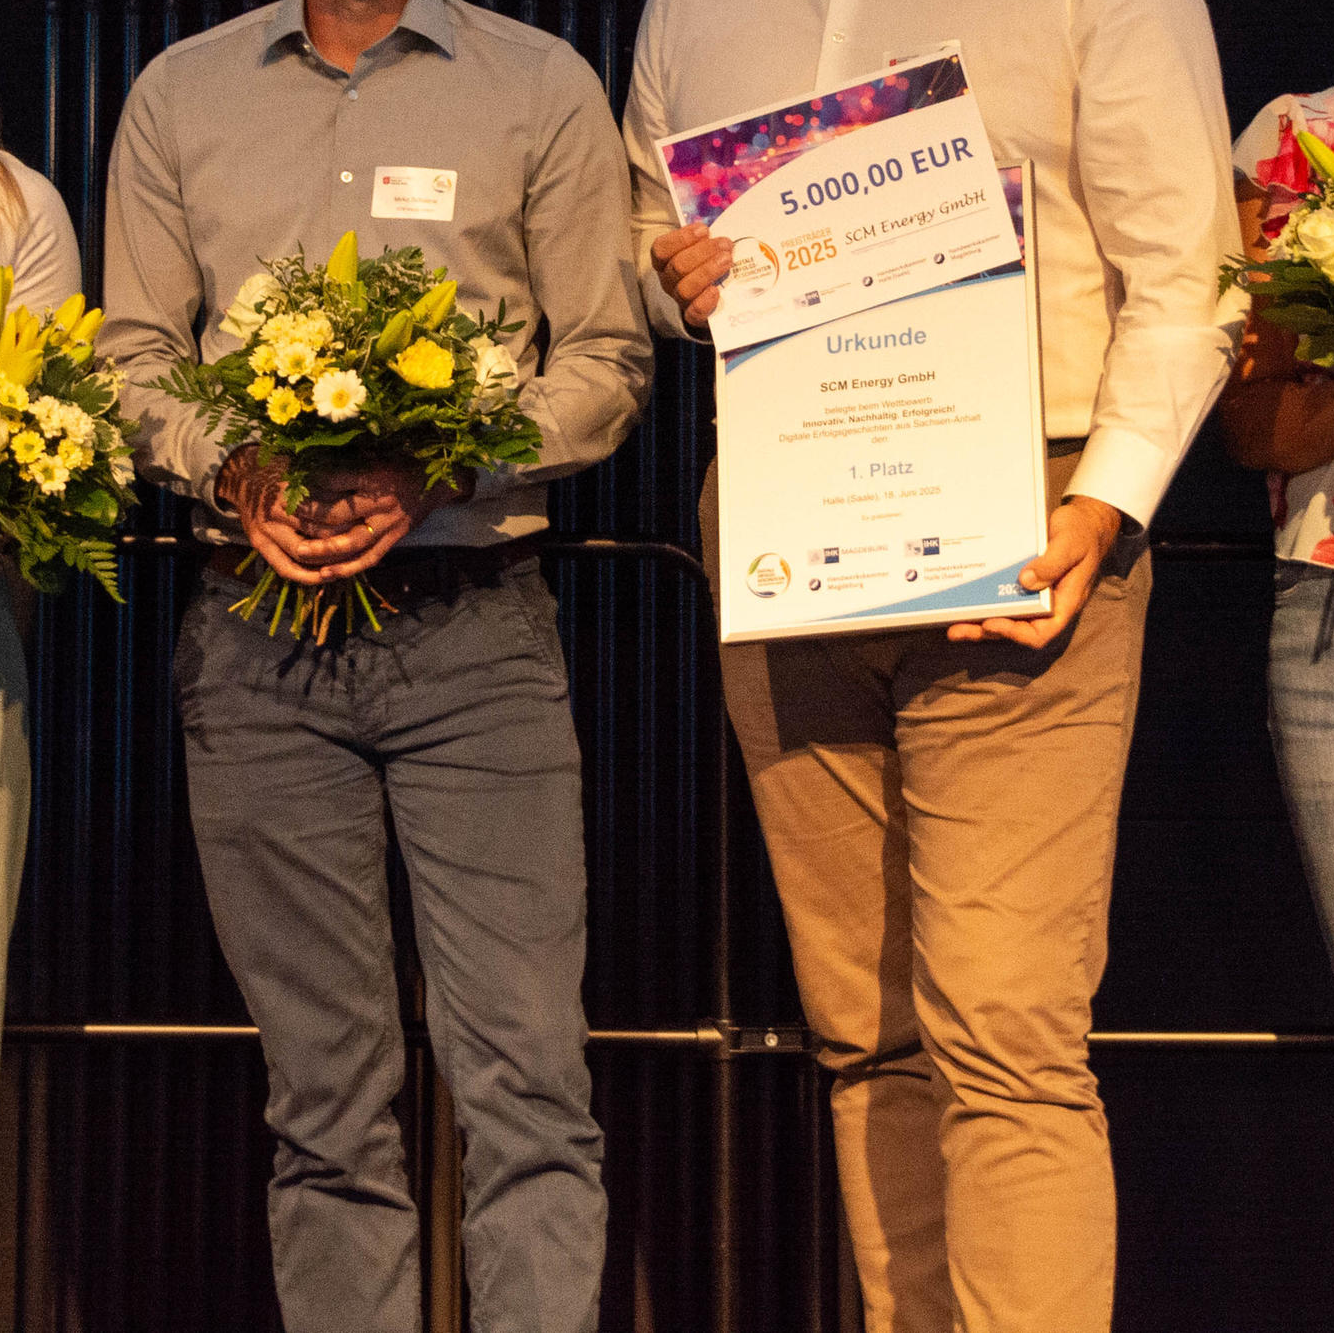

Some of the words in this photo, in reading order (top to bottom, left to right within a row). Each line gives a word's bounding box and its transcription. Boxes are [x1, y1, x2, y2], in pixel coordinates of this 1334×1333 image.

[780, 158, 903, 215] 5.000,00
[910, 137, 973, 175] EUR
[845, 225, 877, 245] SCM
[881, 207, 935, 234] Energy
[939, 188, 987, 215] GmbH
[785, 237, 837, 271] 2025
[827, 327, 927, 354] Urkunde
[820, 380, 848, 393] SCM
[851, 377, 894, 389] Energy
[898, 371, 936, 385] GmbH
[849, 465, 863, 480] 1.
[870, 462, 915, 478] Platz
[998, 583, 1025, 596] 202
